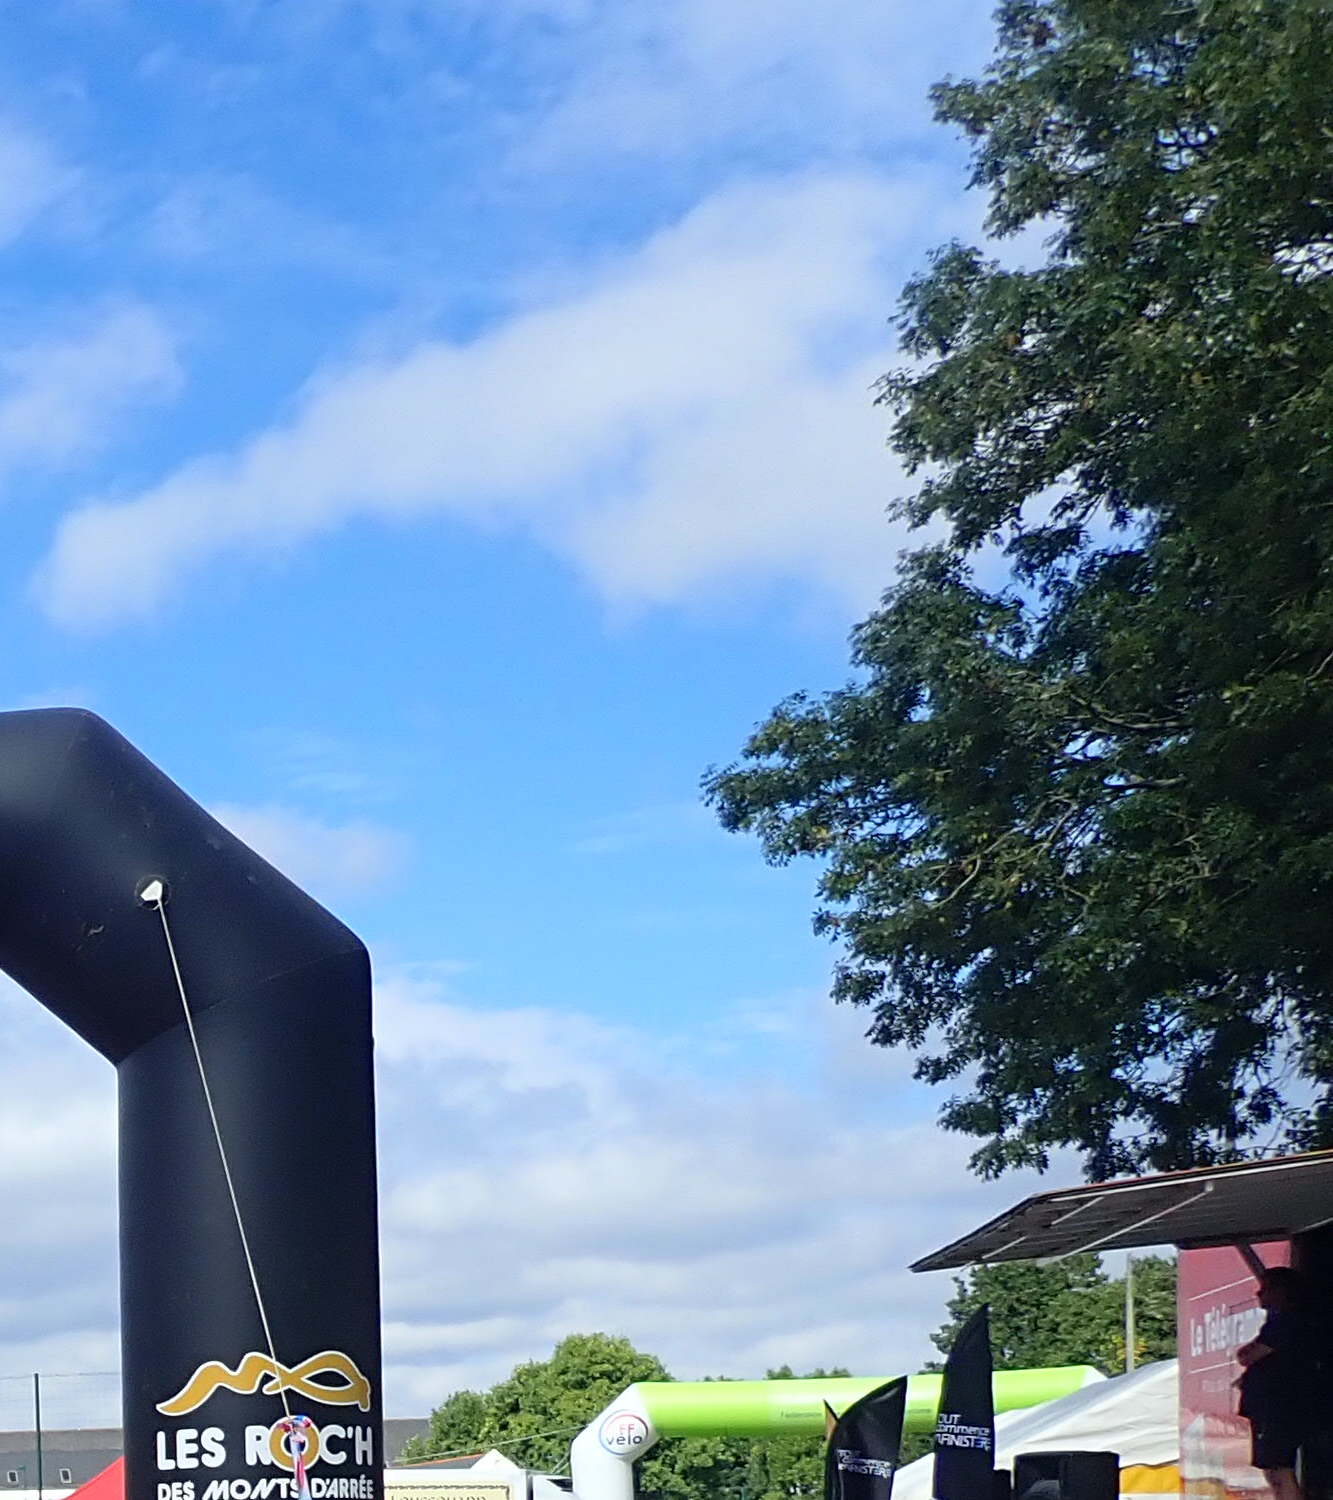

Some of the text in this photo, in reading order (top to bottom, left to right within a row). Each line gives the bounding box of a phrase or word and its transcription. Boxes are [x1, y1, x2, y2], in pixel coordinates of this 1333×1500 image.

[156, 1415, 374, 1473] LES ROC'H
[311, 1473, 374, 1500] D'ARRÉE
